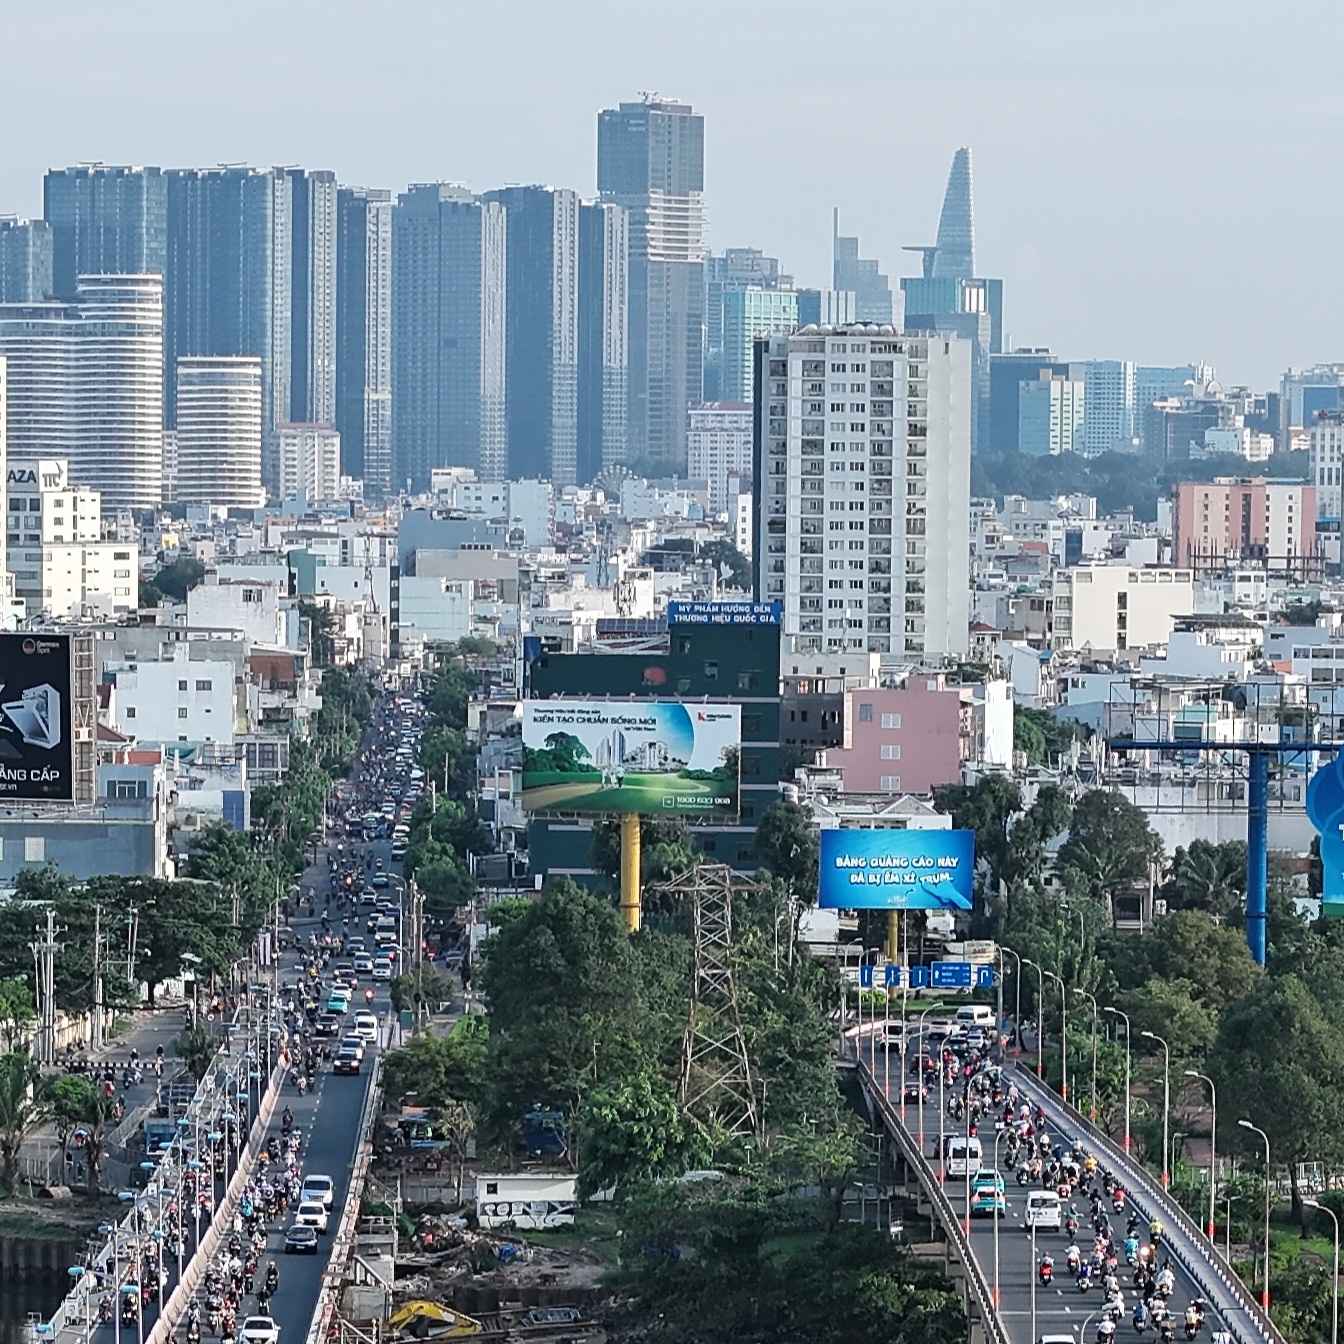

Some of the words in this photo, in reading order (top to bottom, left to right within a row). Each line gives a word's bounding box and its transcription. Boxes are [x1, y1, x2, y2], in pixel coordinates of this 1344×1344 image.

[30, 764, 60, 782] CẤP
[836, 854, 867, 868] BẢNG
[870, 854, 909, 868] QUẢNG
[912, 854, 934, 868] CÁO
[937, 854, 959, 868] NÀY
